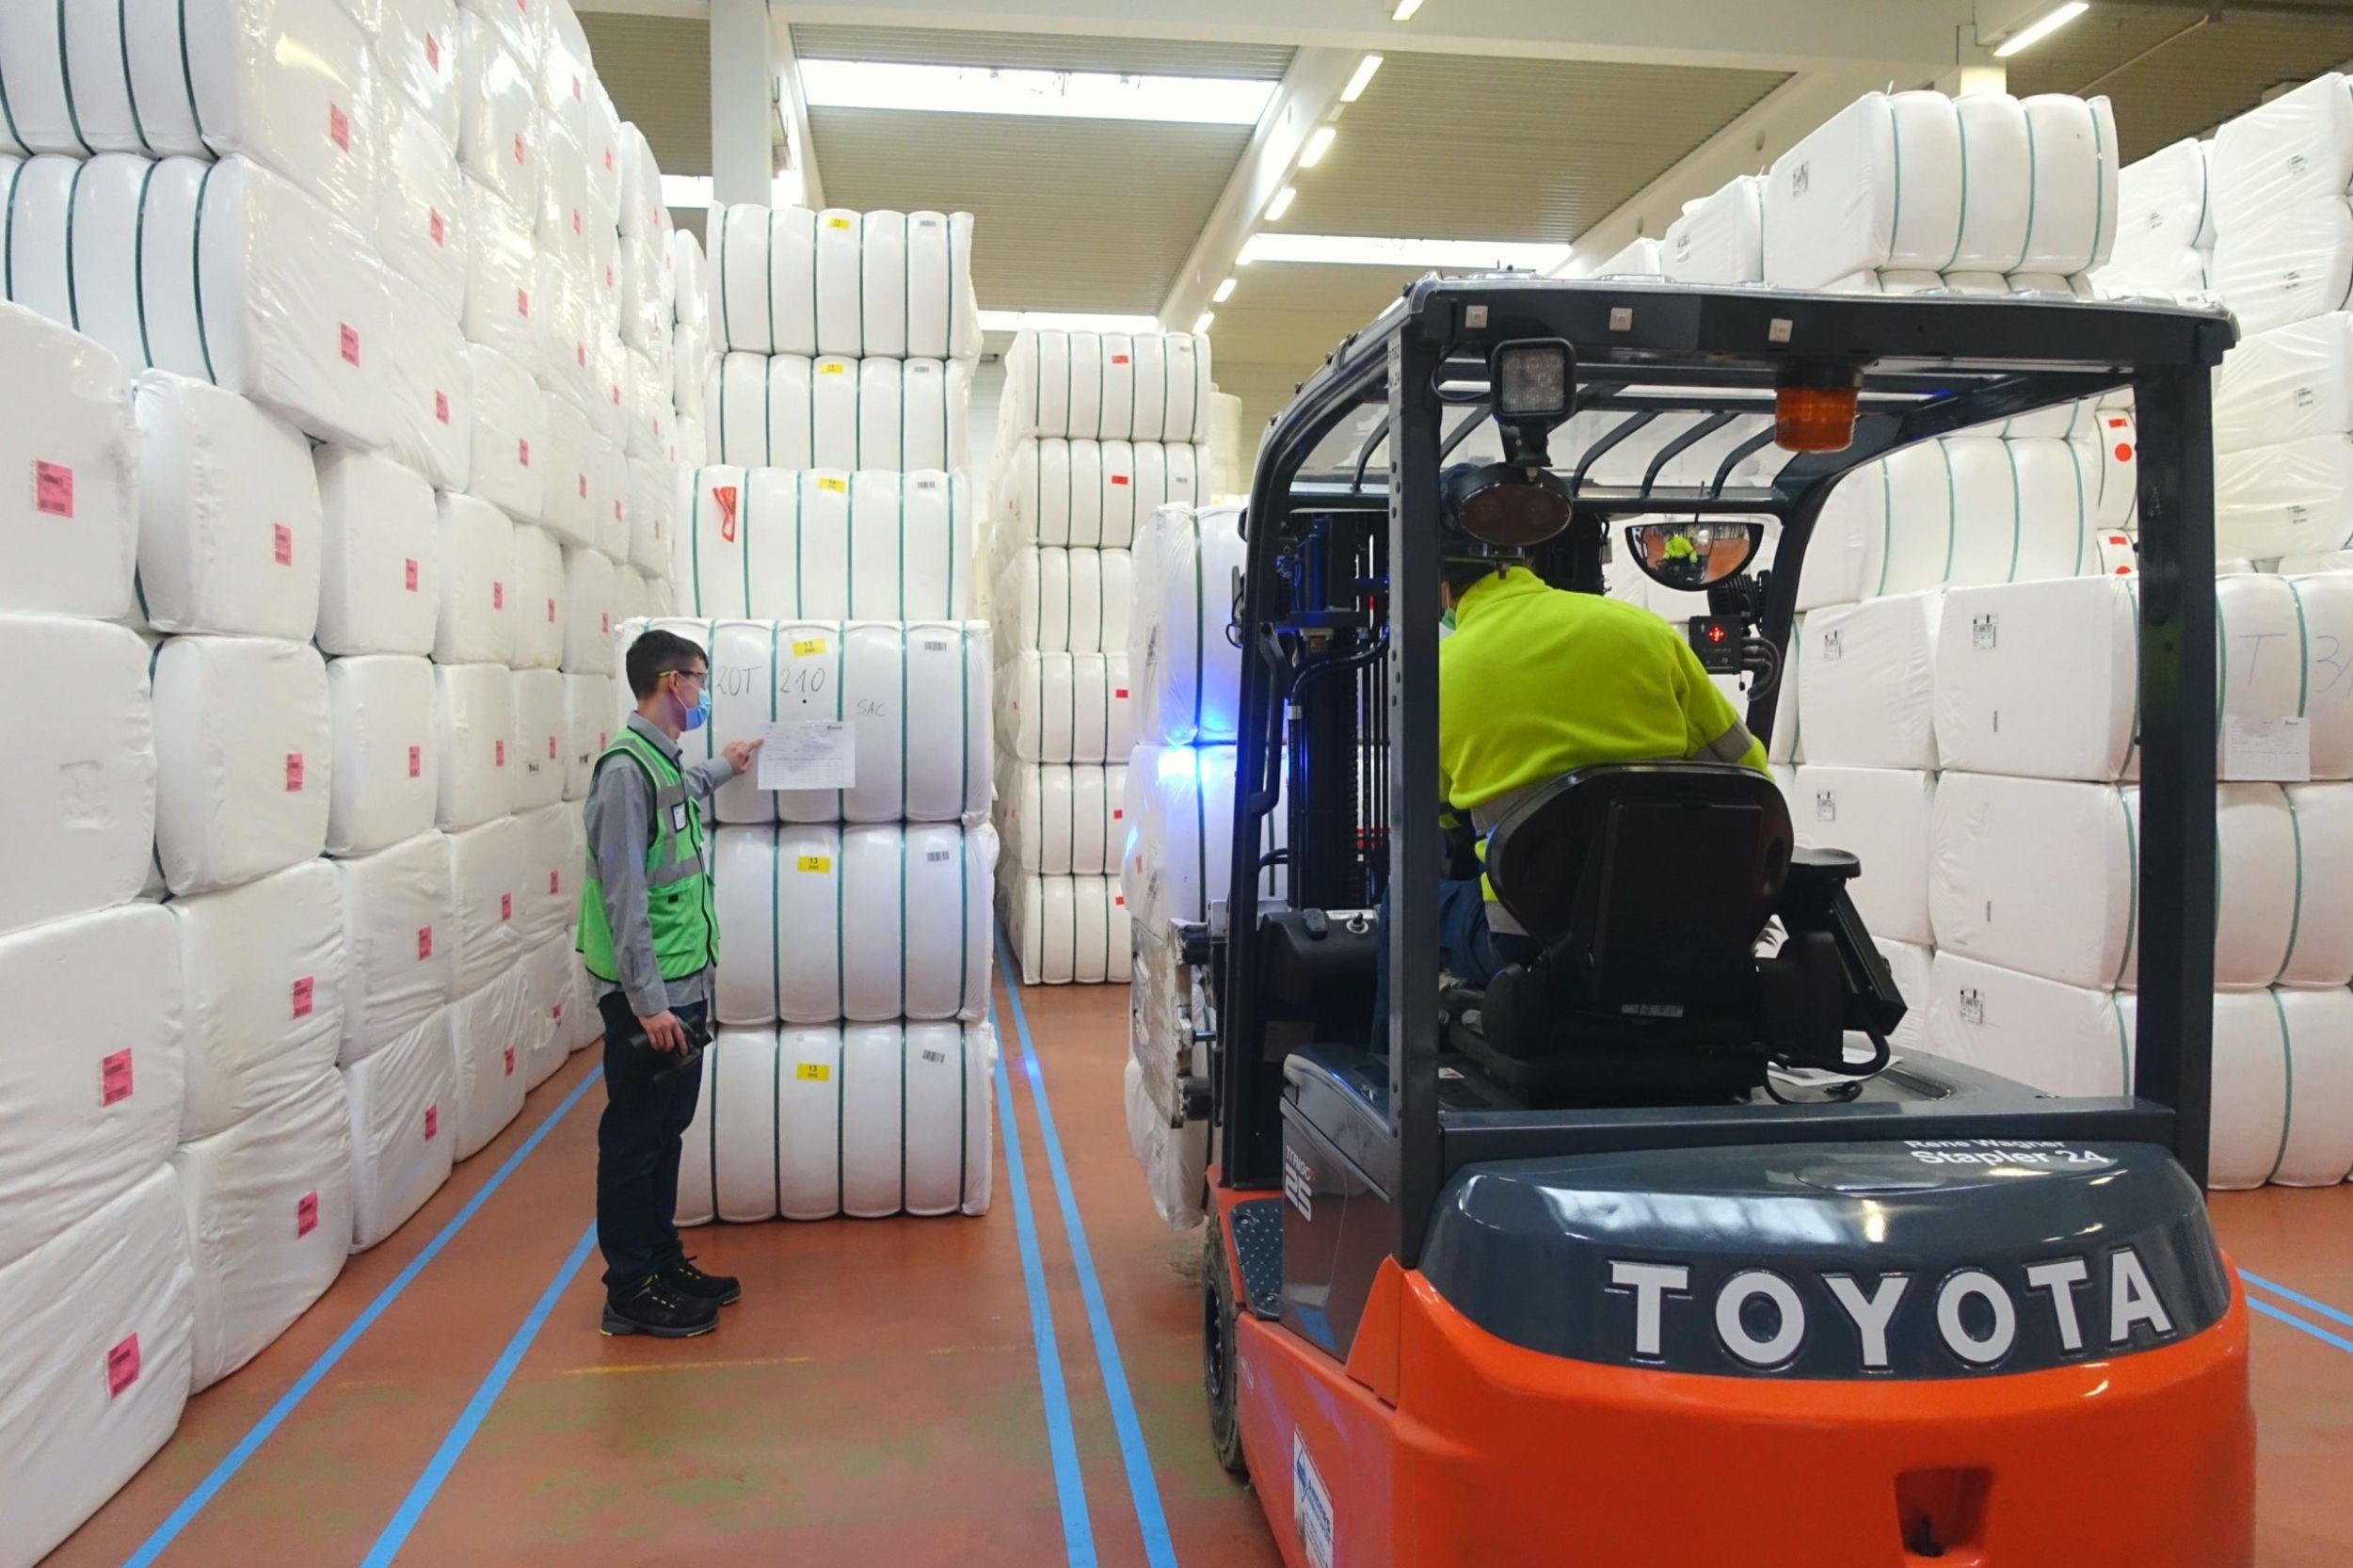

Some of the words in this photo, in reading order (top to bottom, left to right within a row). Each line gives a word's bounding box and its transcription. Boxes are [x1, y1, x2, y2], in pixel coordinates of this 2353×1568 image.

[779, 666, 825, 694] 210
[856, 698, 886, 717] SAC
[1910, 1150, 2052, 1166] Stapler
[2054, 1149, 2111, 1163] 24
[1285, 1161, 1313, 1223] 25
[1609, 1249, 2175, 1368] TOYOTA
